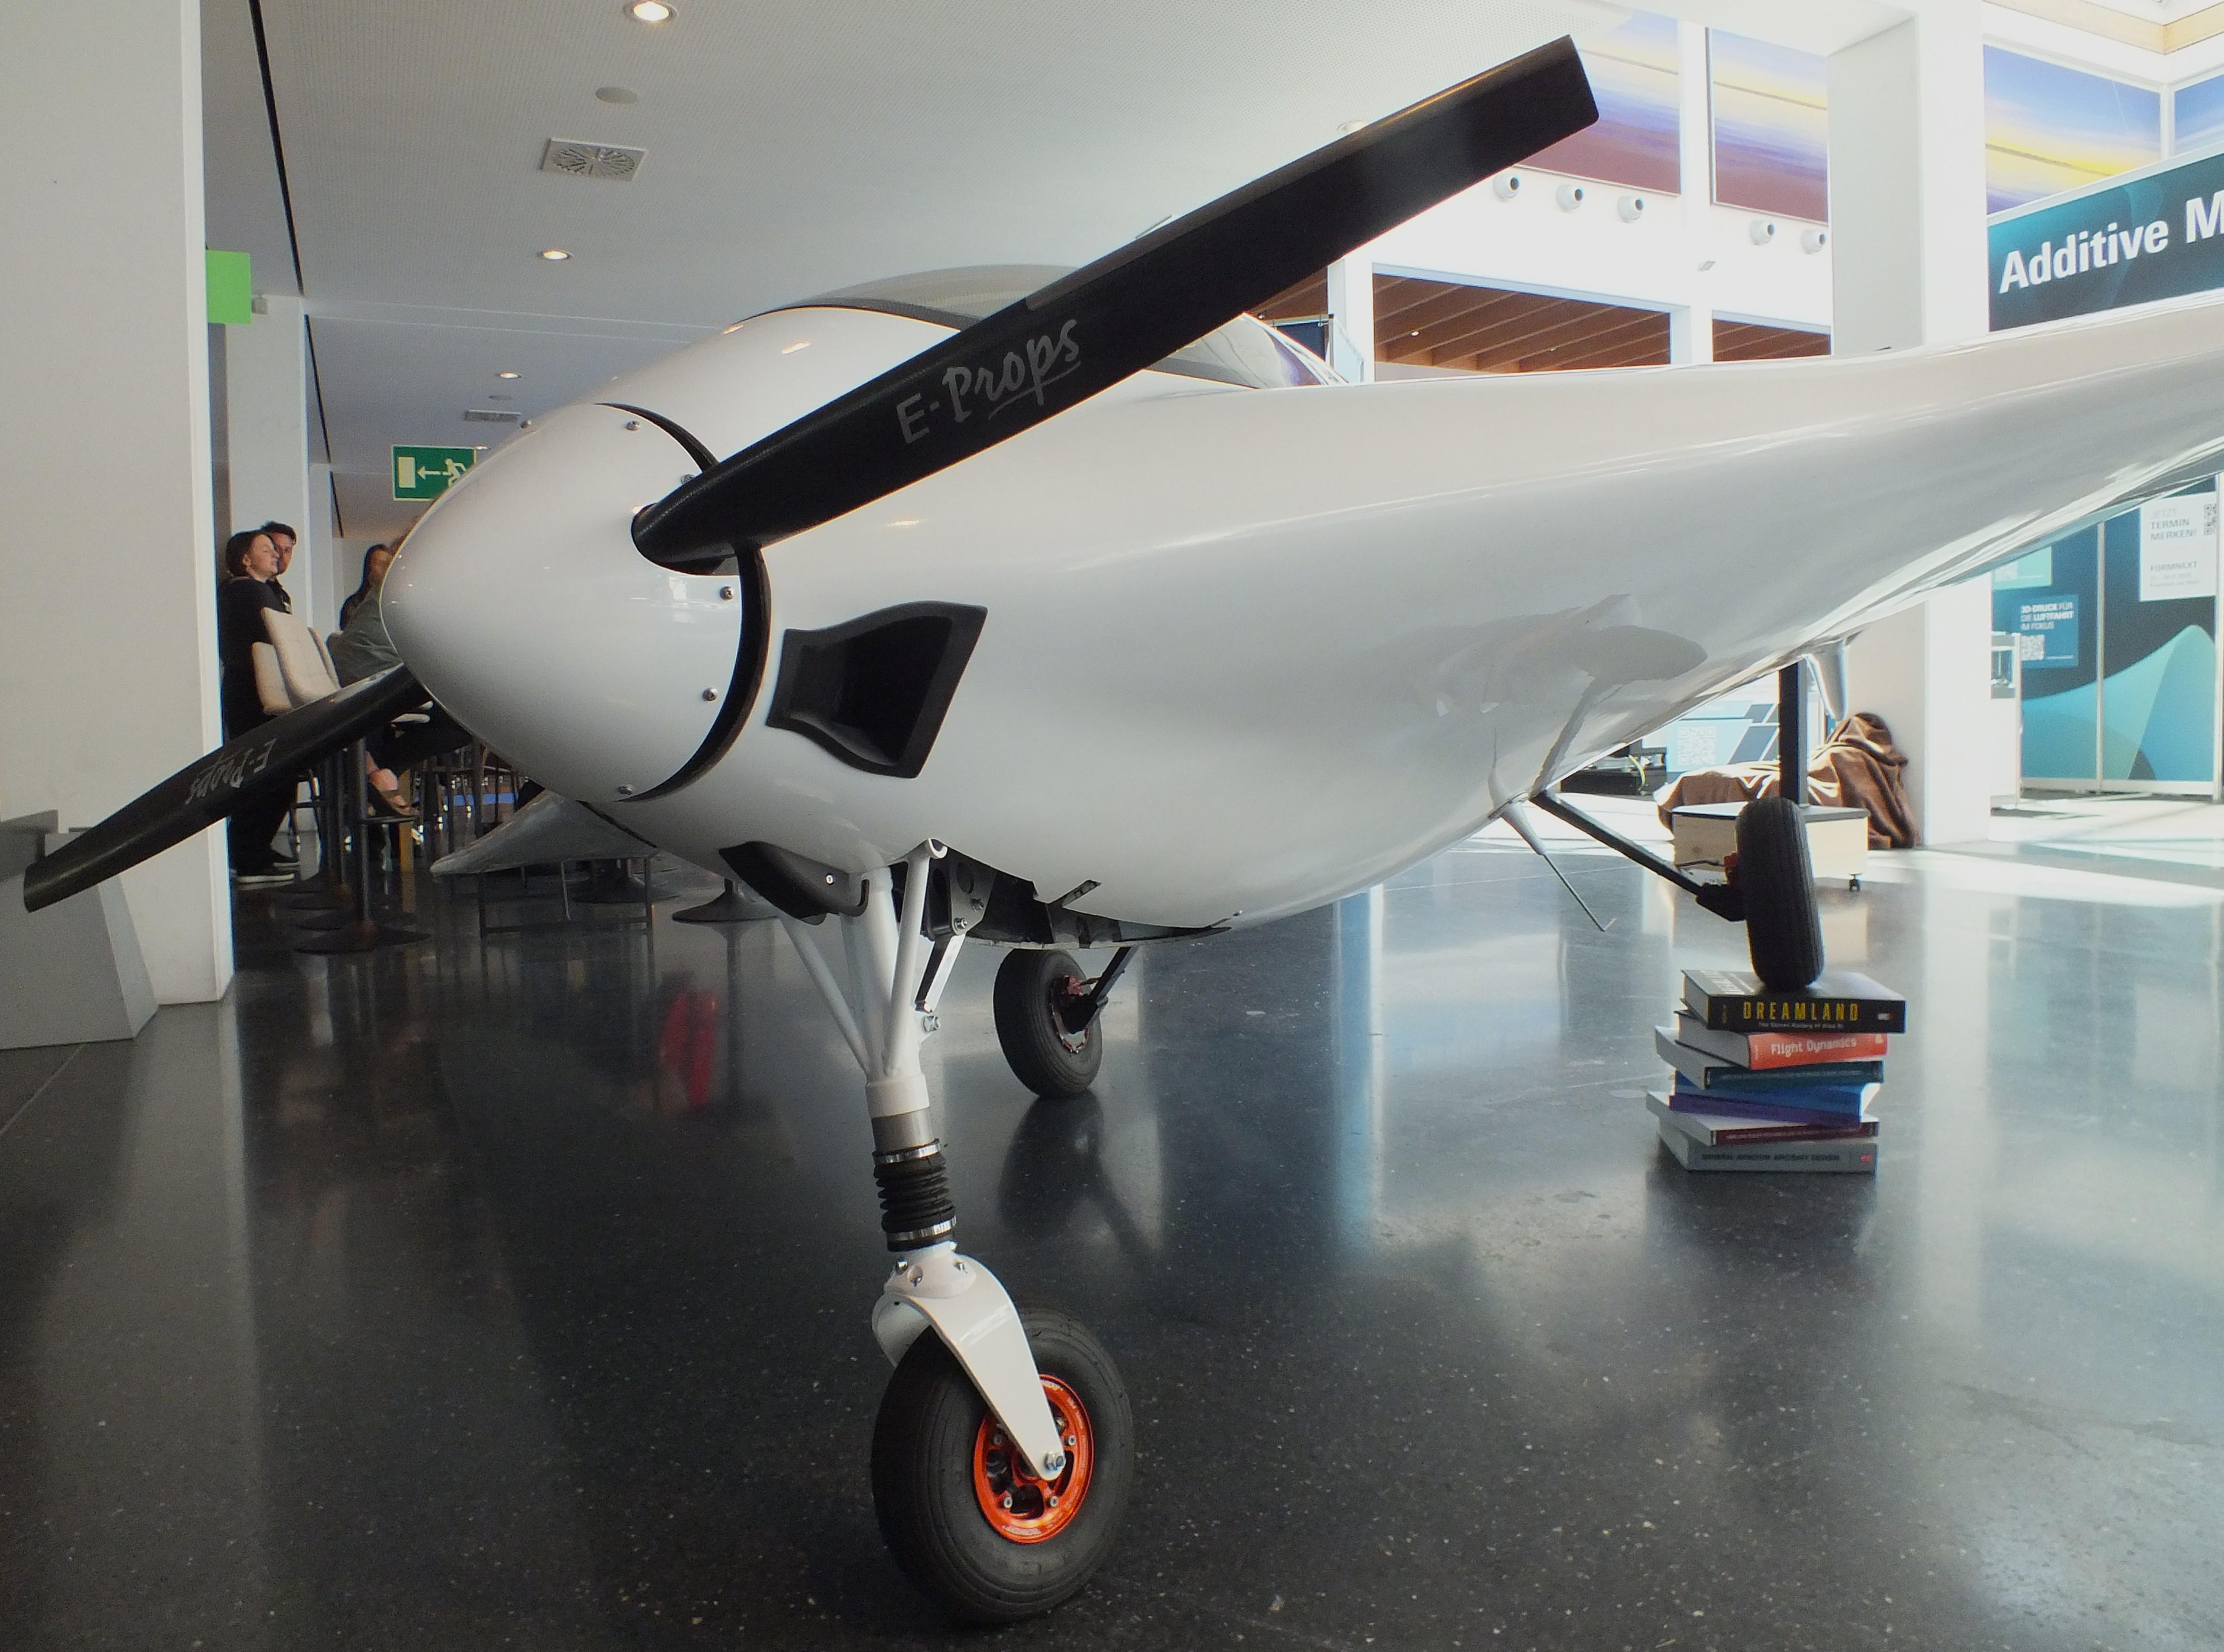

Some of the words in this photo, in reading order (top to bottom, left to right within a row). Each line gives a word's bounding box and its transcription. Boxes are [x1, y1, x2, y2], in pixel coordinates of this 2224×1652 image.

[1999, 221, 2169, 294] Additive
[896, 319, 1080, 444] E-Props
[2151, 519, 2190, 529] TERMIN
[1743, 1001, 1859, 1021] DREAMLAND
[1771, 1041, 1803, 1057] Flight
[1806, 1035, 1857, 1053] Dynamics
